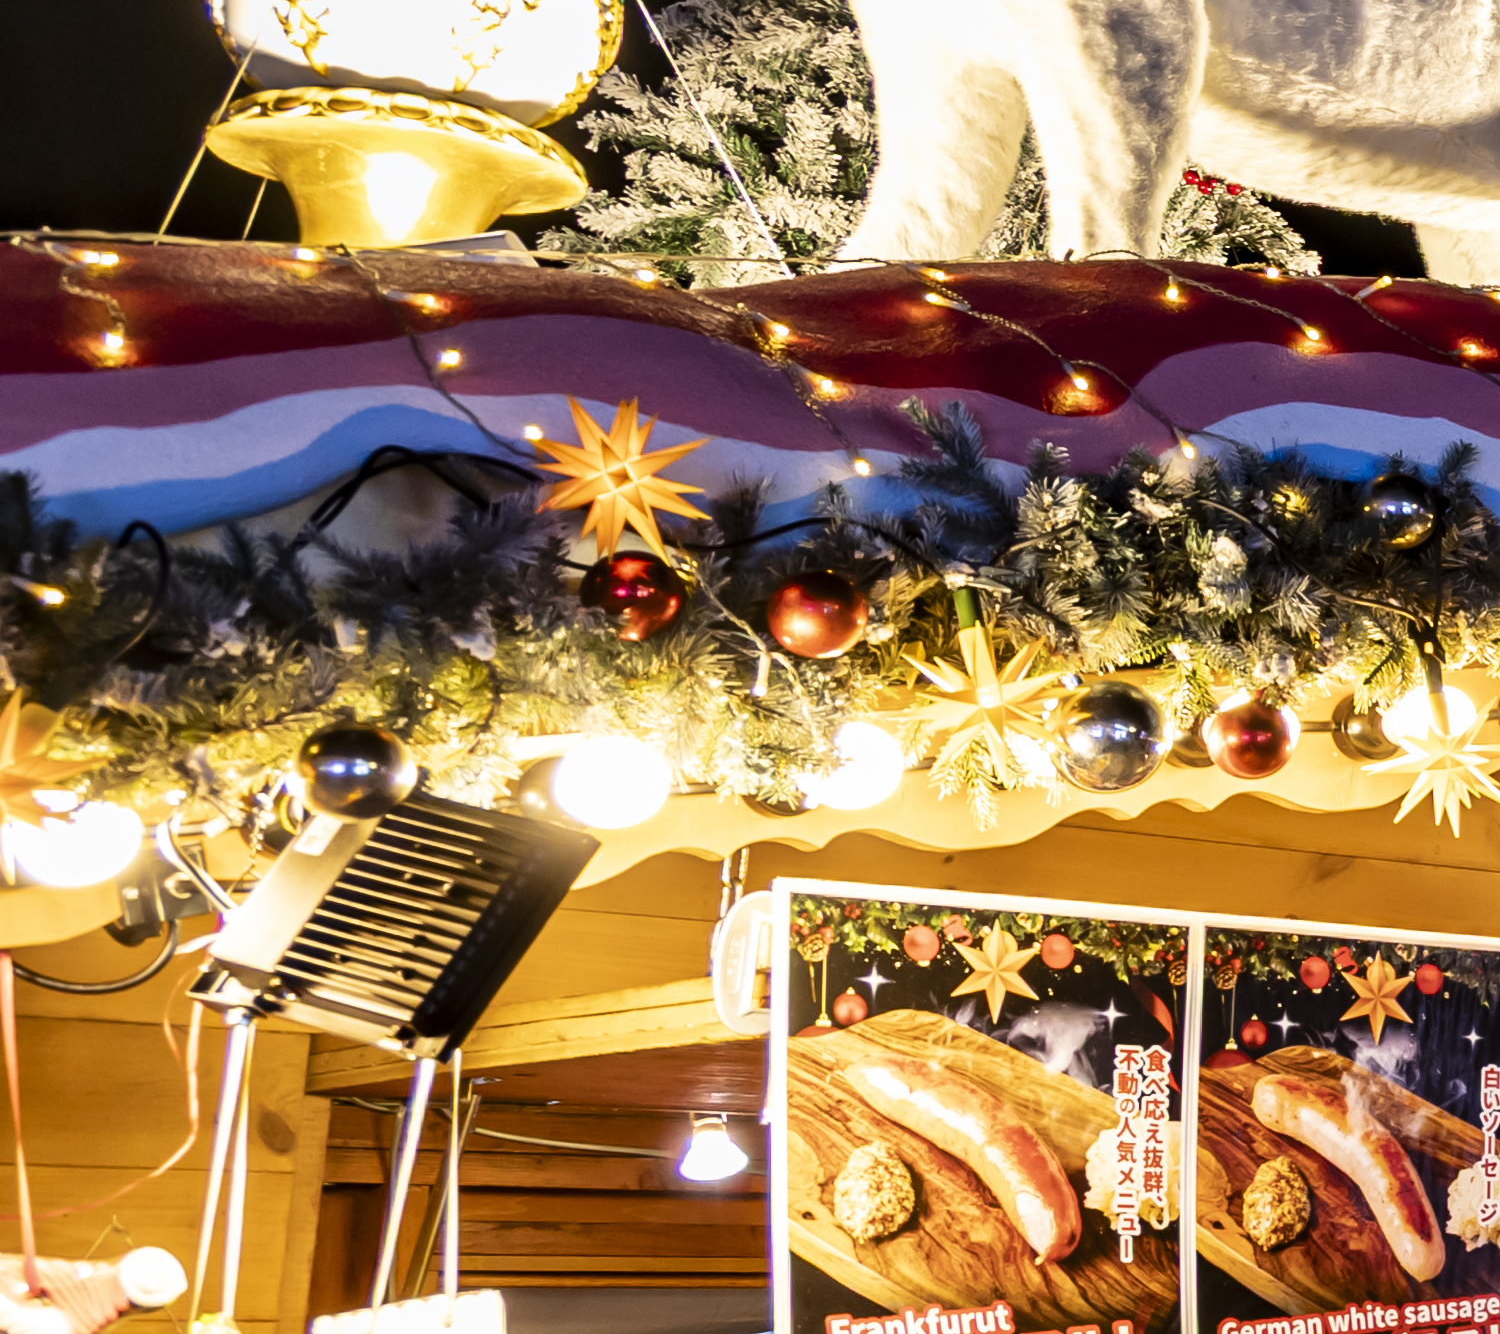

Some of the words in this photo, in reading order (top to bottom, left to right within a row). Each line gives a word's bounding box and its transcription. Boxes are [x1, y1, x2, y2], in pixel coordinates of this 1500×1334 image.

[1117, 1048, 1140, 1258] 不動の人気メニュー
[1143, 1049, 1167, 1202] 食べ応え抜群、
[1481, 1068, 1500, 1223] 白いソーセージ
[1329, 1306, 1399, 1333] white
[1404, 1297, 1500, 1325] sausage
